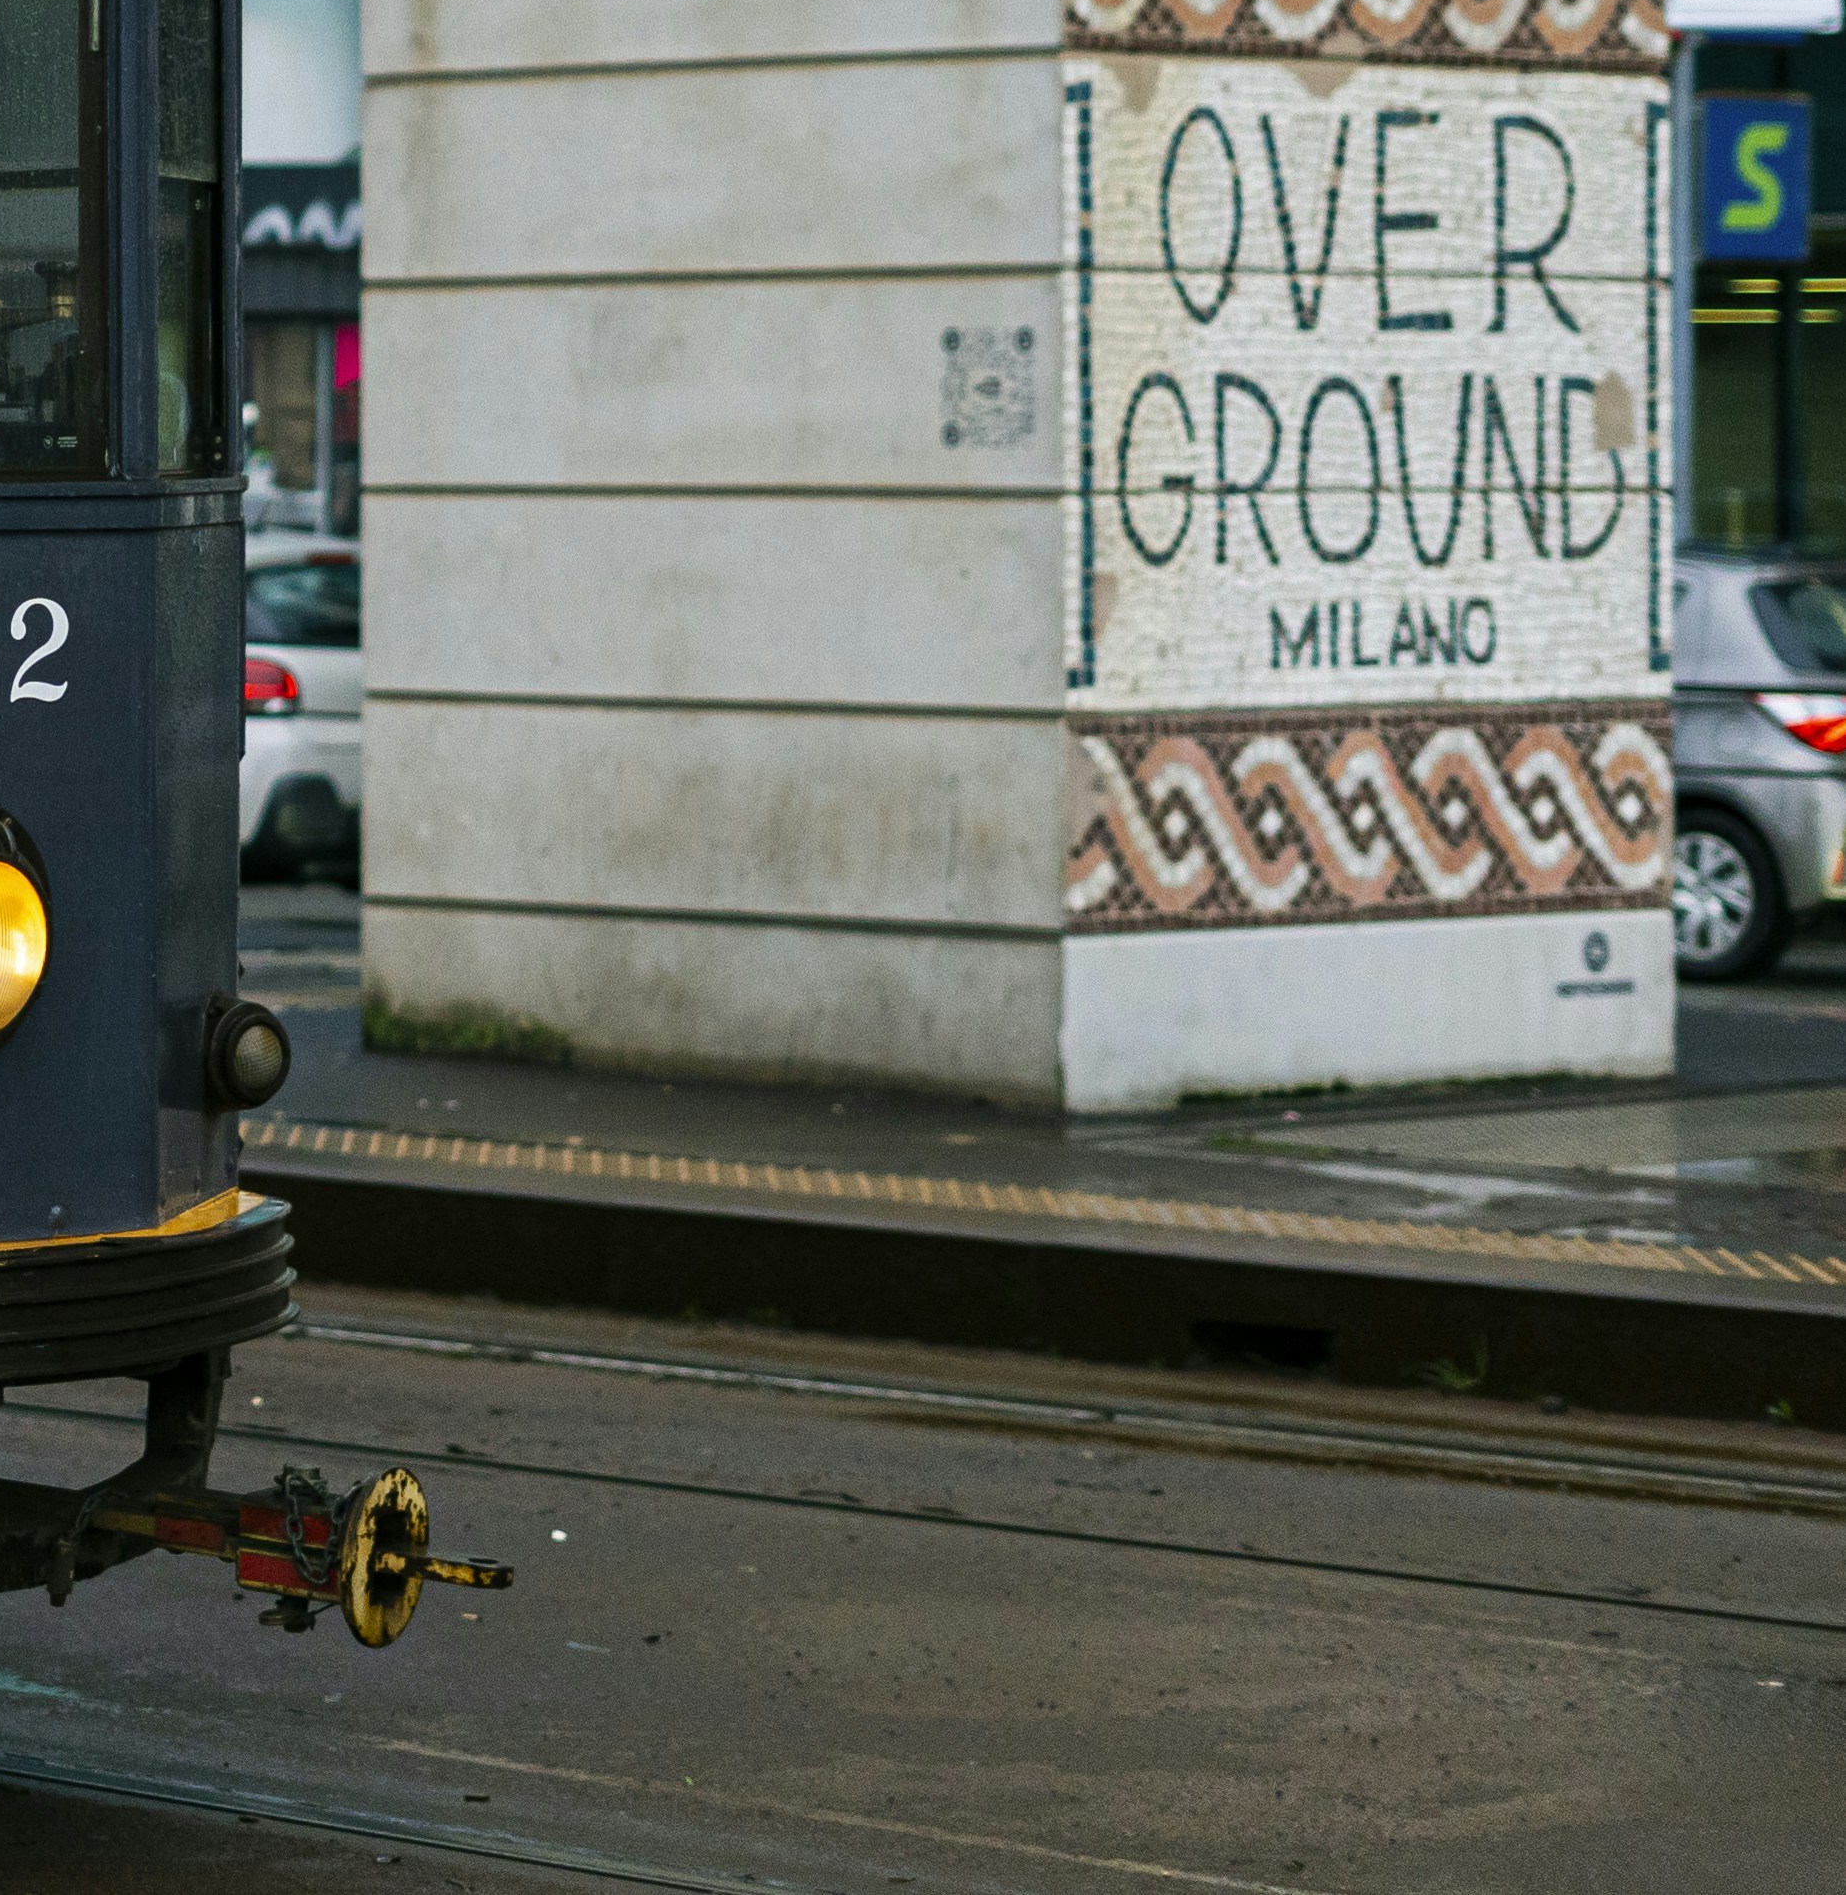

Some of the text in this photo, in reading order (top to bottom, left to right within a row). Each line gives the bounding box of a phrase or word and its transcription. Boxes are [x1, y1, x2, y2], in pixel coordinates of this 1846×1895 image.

[1159, 105, 1582, 334] OVER
[1117, 371, 1628, 568] GROUND
[1268, 597, 1498, 671] MILANO
